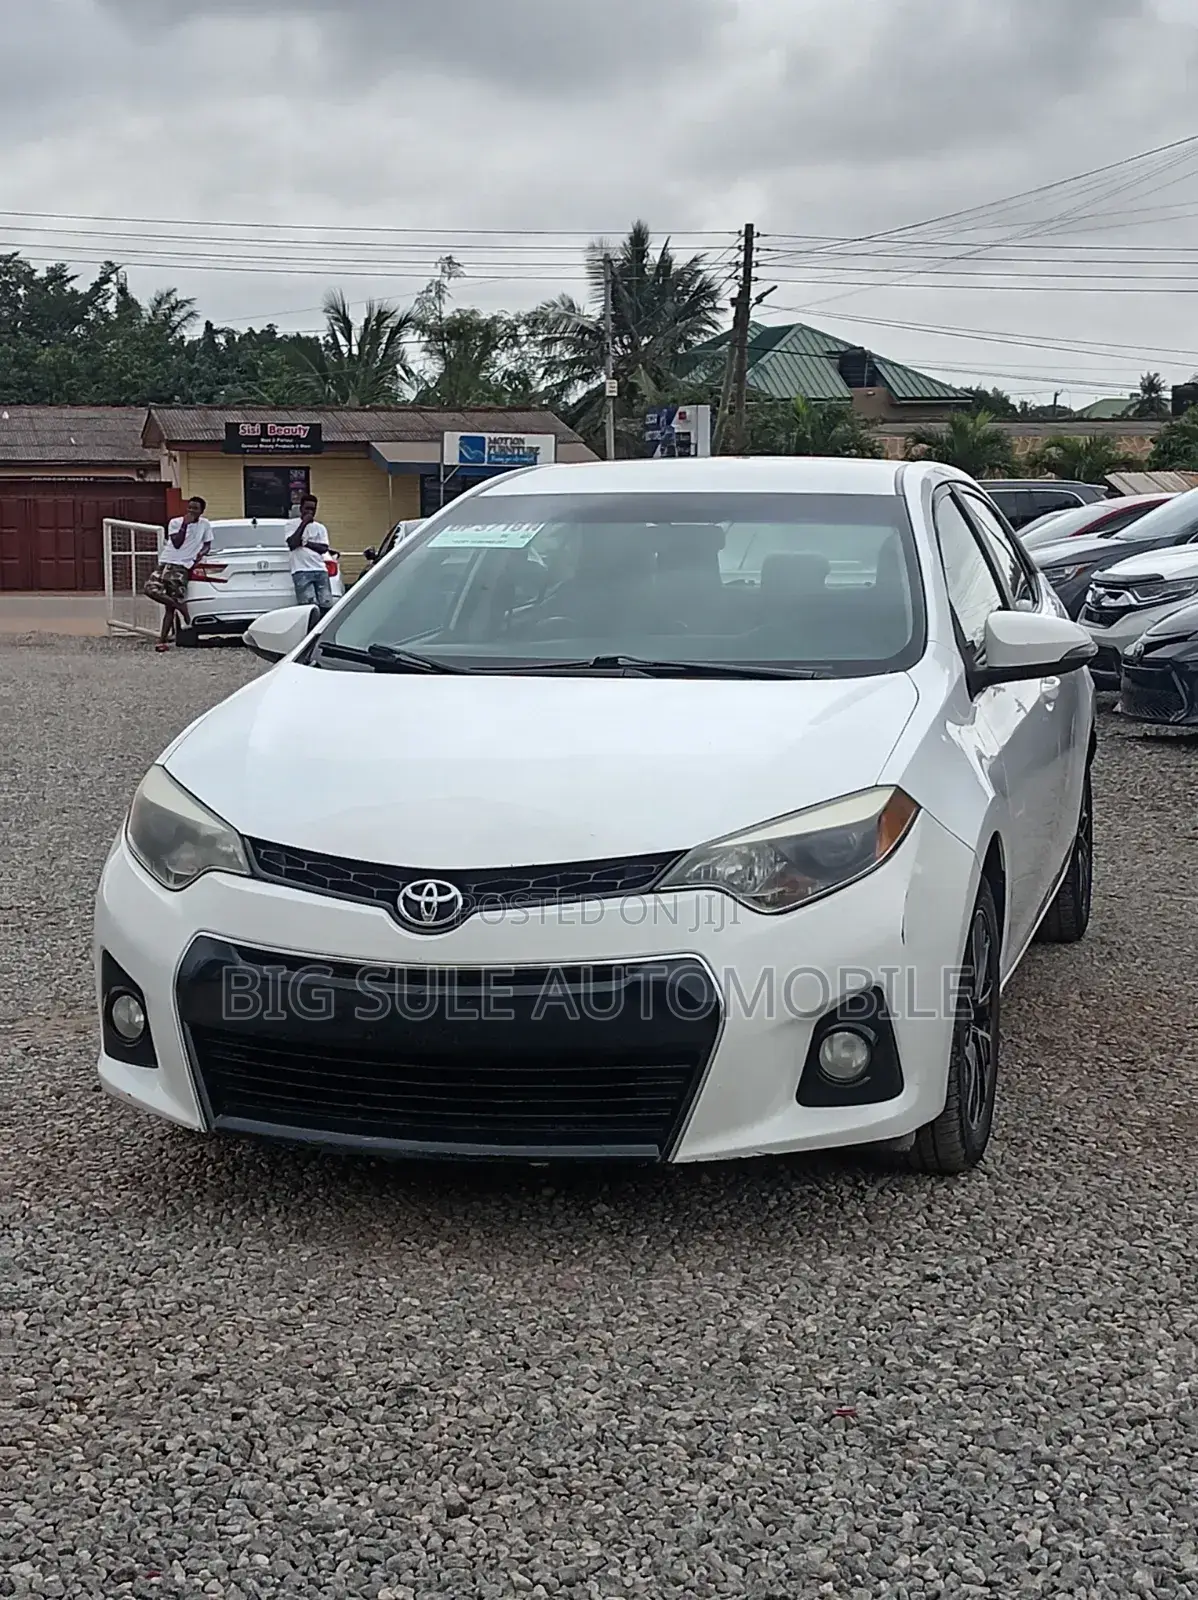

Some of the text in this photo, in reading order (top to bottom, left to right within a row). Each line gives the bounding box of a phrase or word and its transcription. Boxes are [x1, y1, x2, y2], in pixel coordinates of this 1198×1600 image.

[239, 424, 310, 438] Sisi Beauty
[488, 436, 526, 445] MOTION
